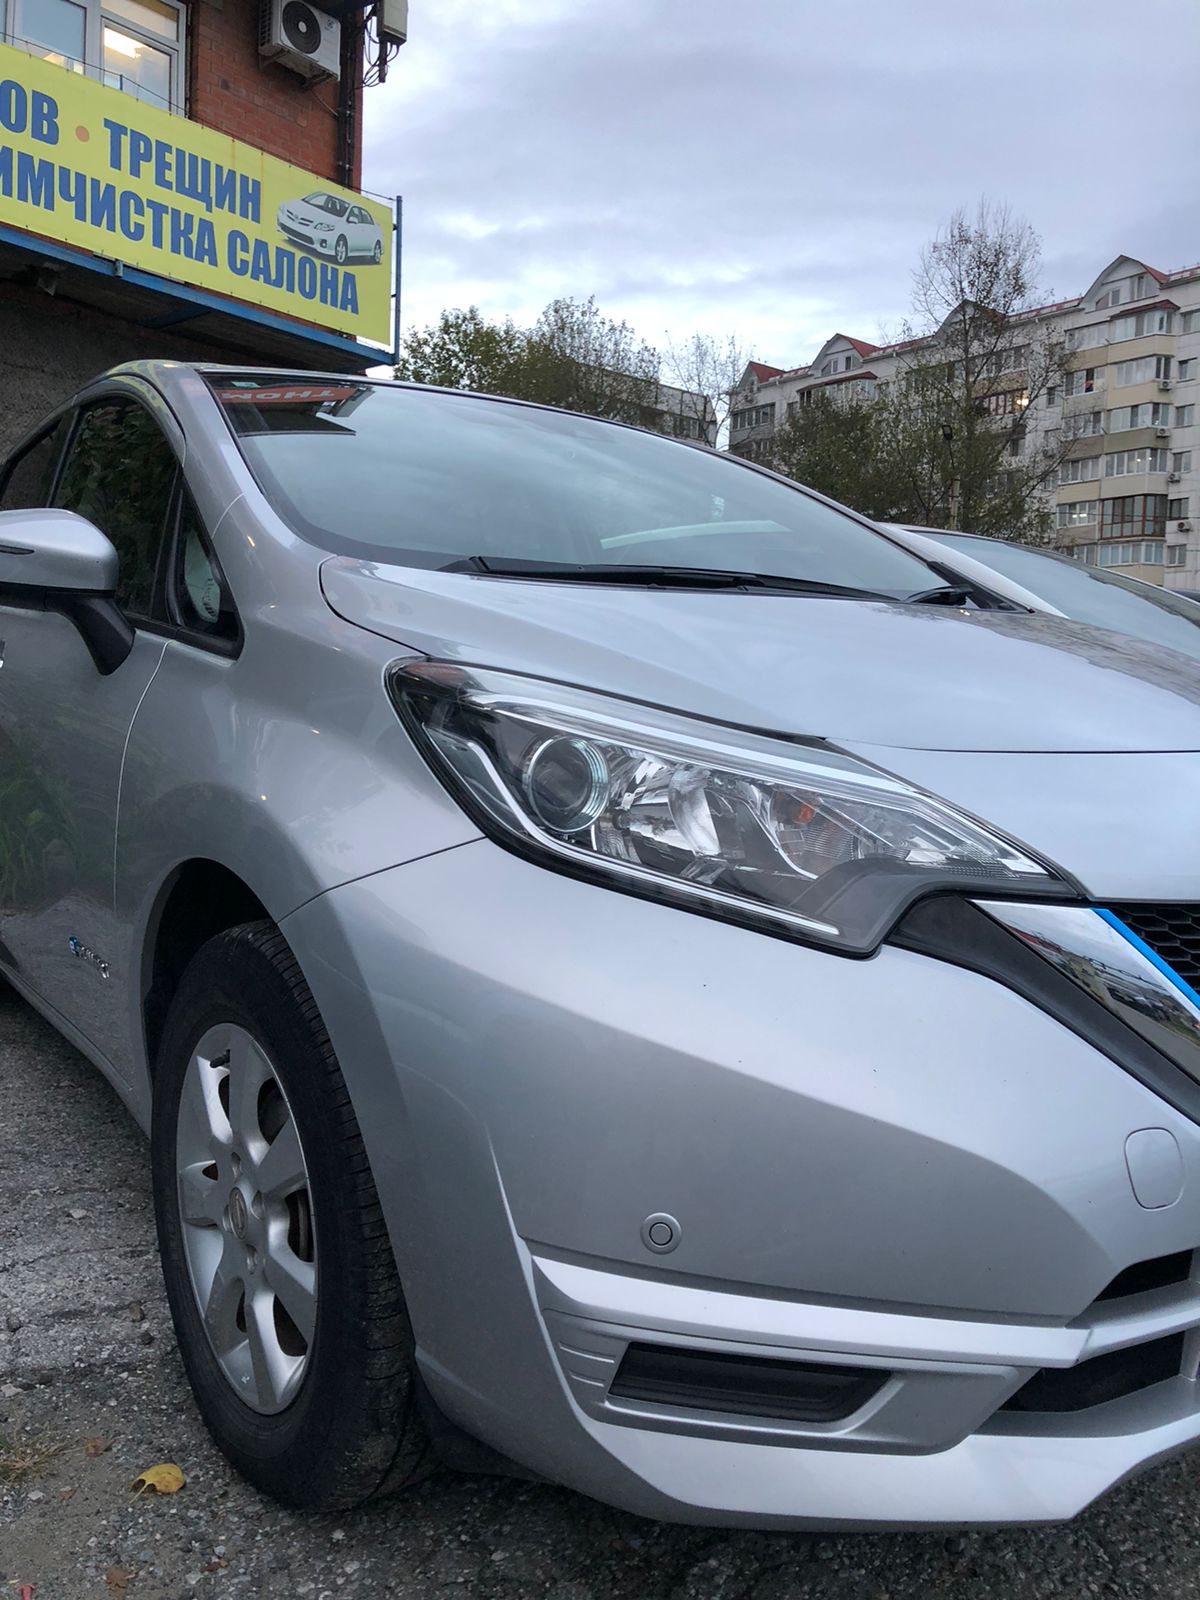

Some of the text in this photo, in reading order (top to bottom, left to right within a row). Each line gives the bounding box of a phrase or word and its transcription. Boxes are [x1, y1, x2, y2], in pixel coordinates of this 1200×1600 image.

[0, 79, 261, 225] ОВ ТРЕЩИН
[227, 229, 359, 315] САЛОНА
